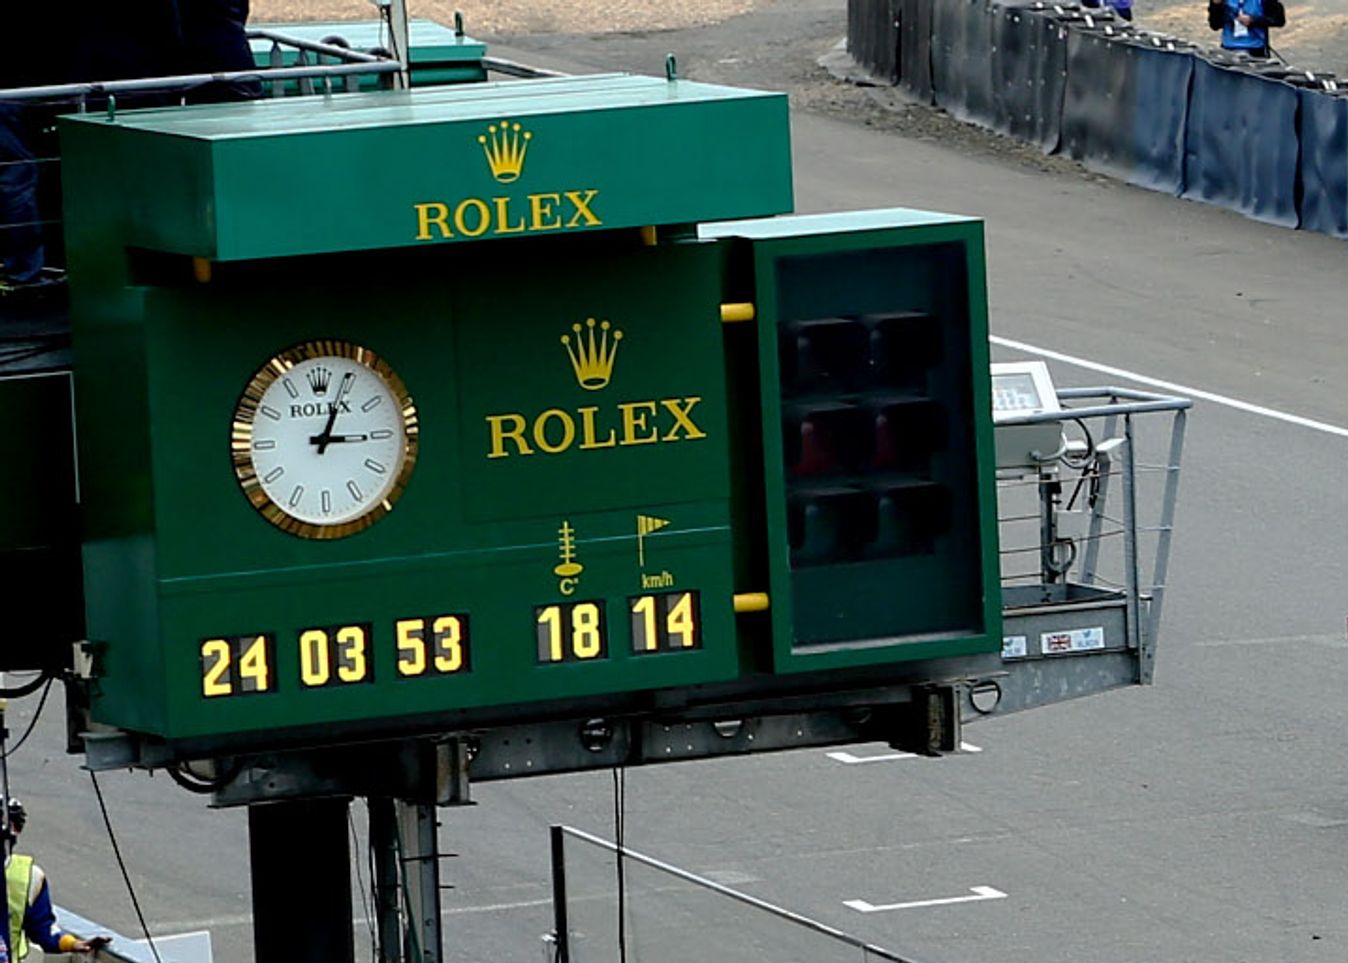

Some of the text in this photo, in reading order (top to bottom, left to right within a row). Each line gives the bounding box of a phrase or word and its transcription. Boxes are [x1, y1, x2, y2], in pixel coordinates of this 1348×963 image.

[414, 190, 602, 240] ROLEX
[486, 397, 707, 458] ROLEX
[642, 571, 673, 589] km/h
[537, 603, 600, 661] 18
[632, 592, 694, 650] 14
[201, 616, 462, 696] 24 03 53
